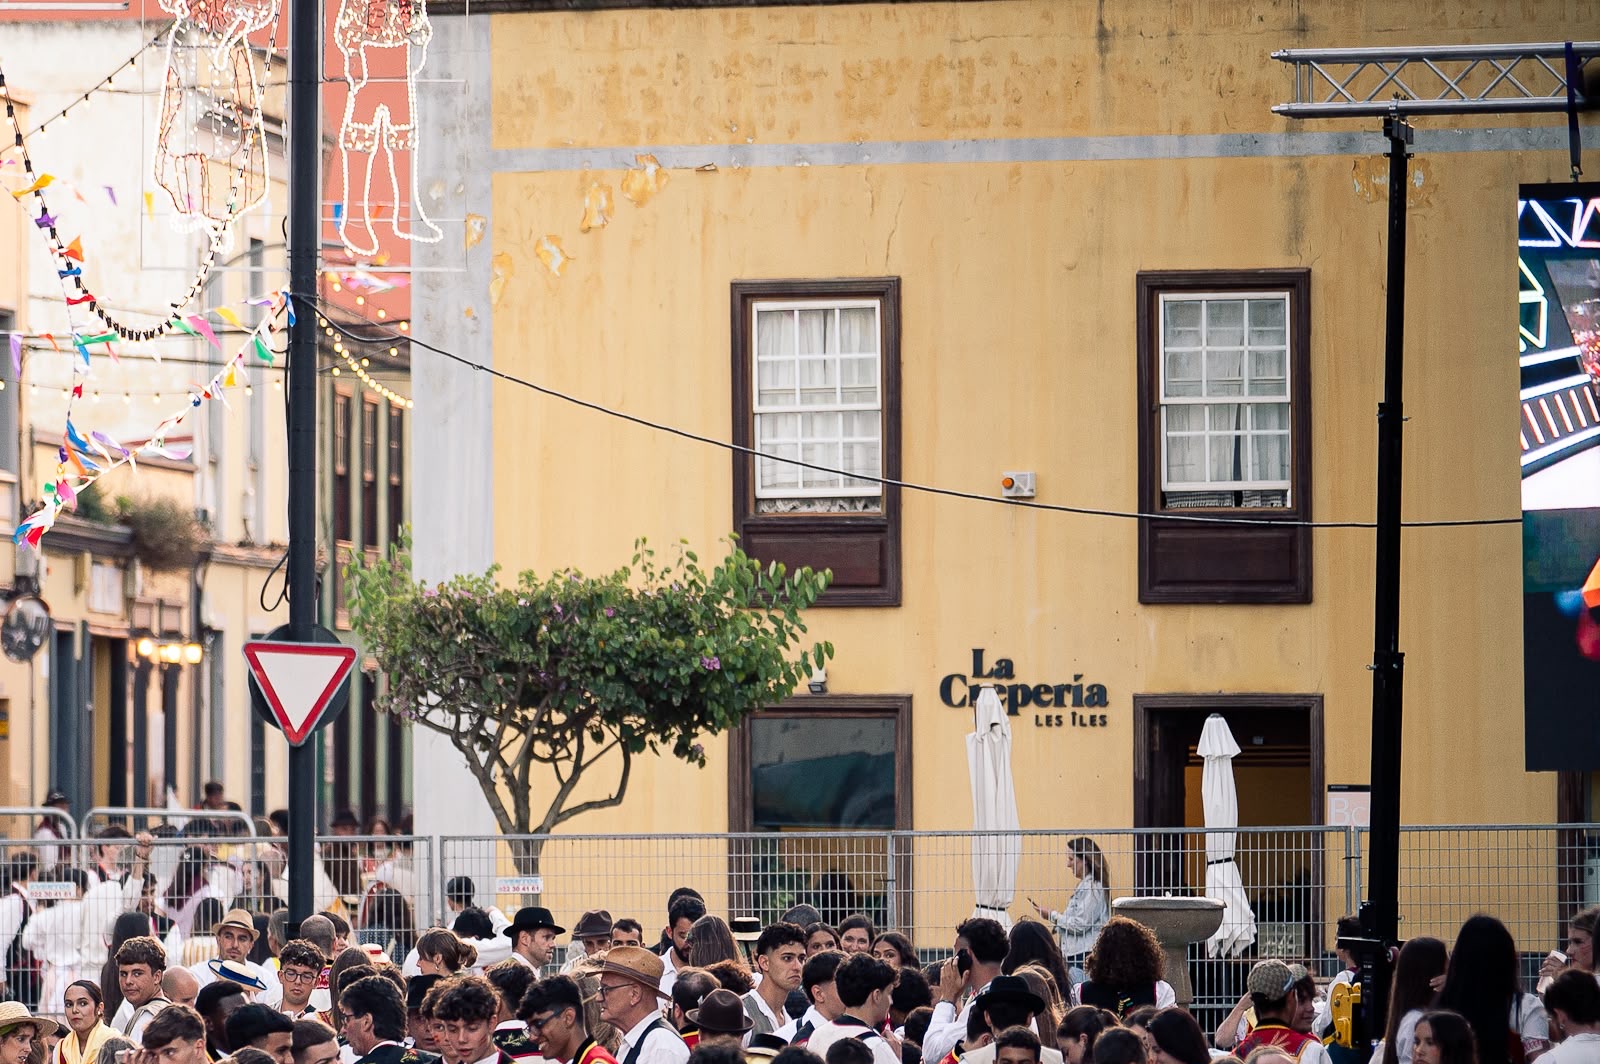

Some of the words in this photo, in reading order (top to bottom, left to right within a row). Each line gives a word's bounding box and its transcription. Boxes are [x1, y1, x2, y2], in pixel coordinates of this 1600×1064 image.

[971, 648, 1016, 680] La
[1035, 714, 1063, 727] LES
[1071, 711, 1108, 727] ÎLES
